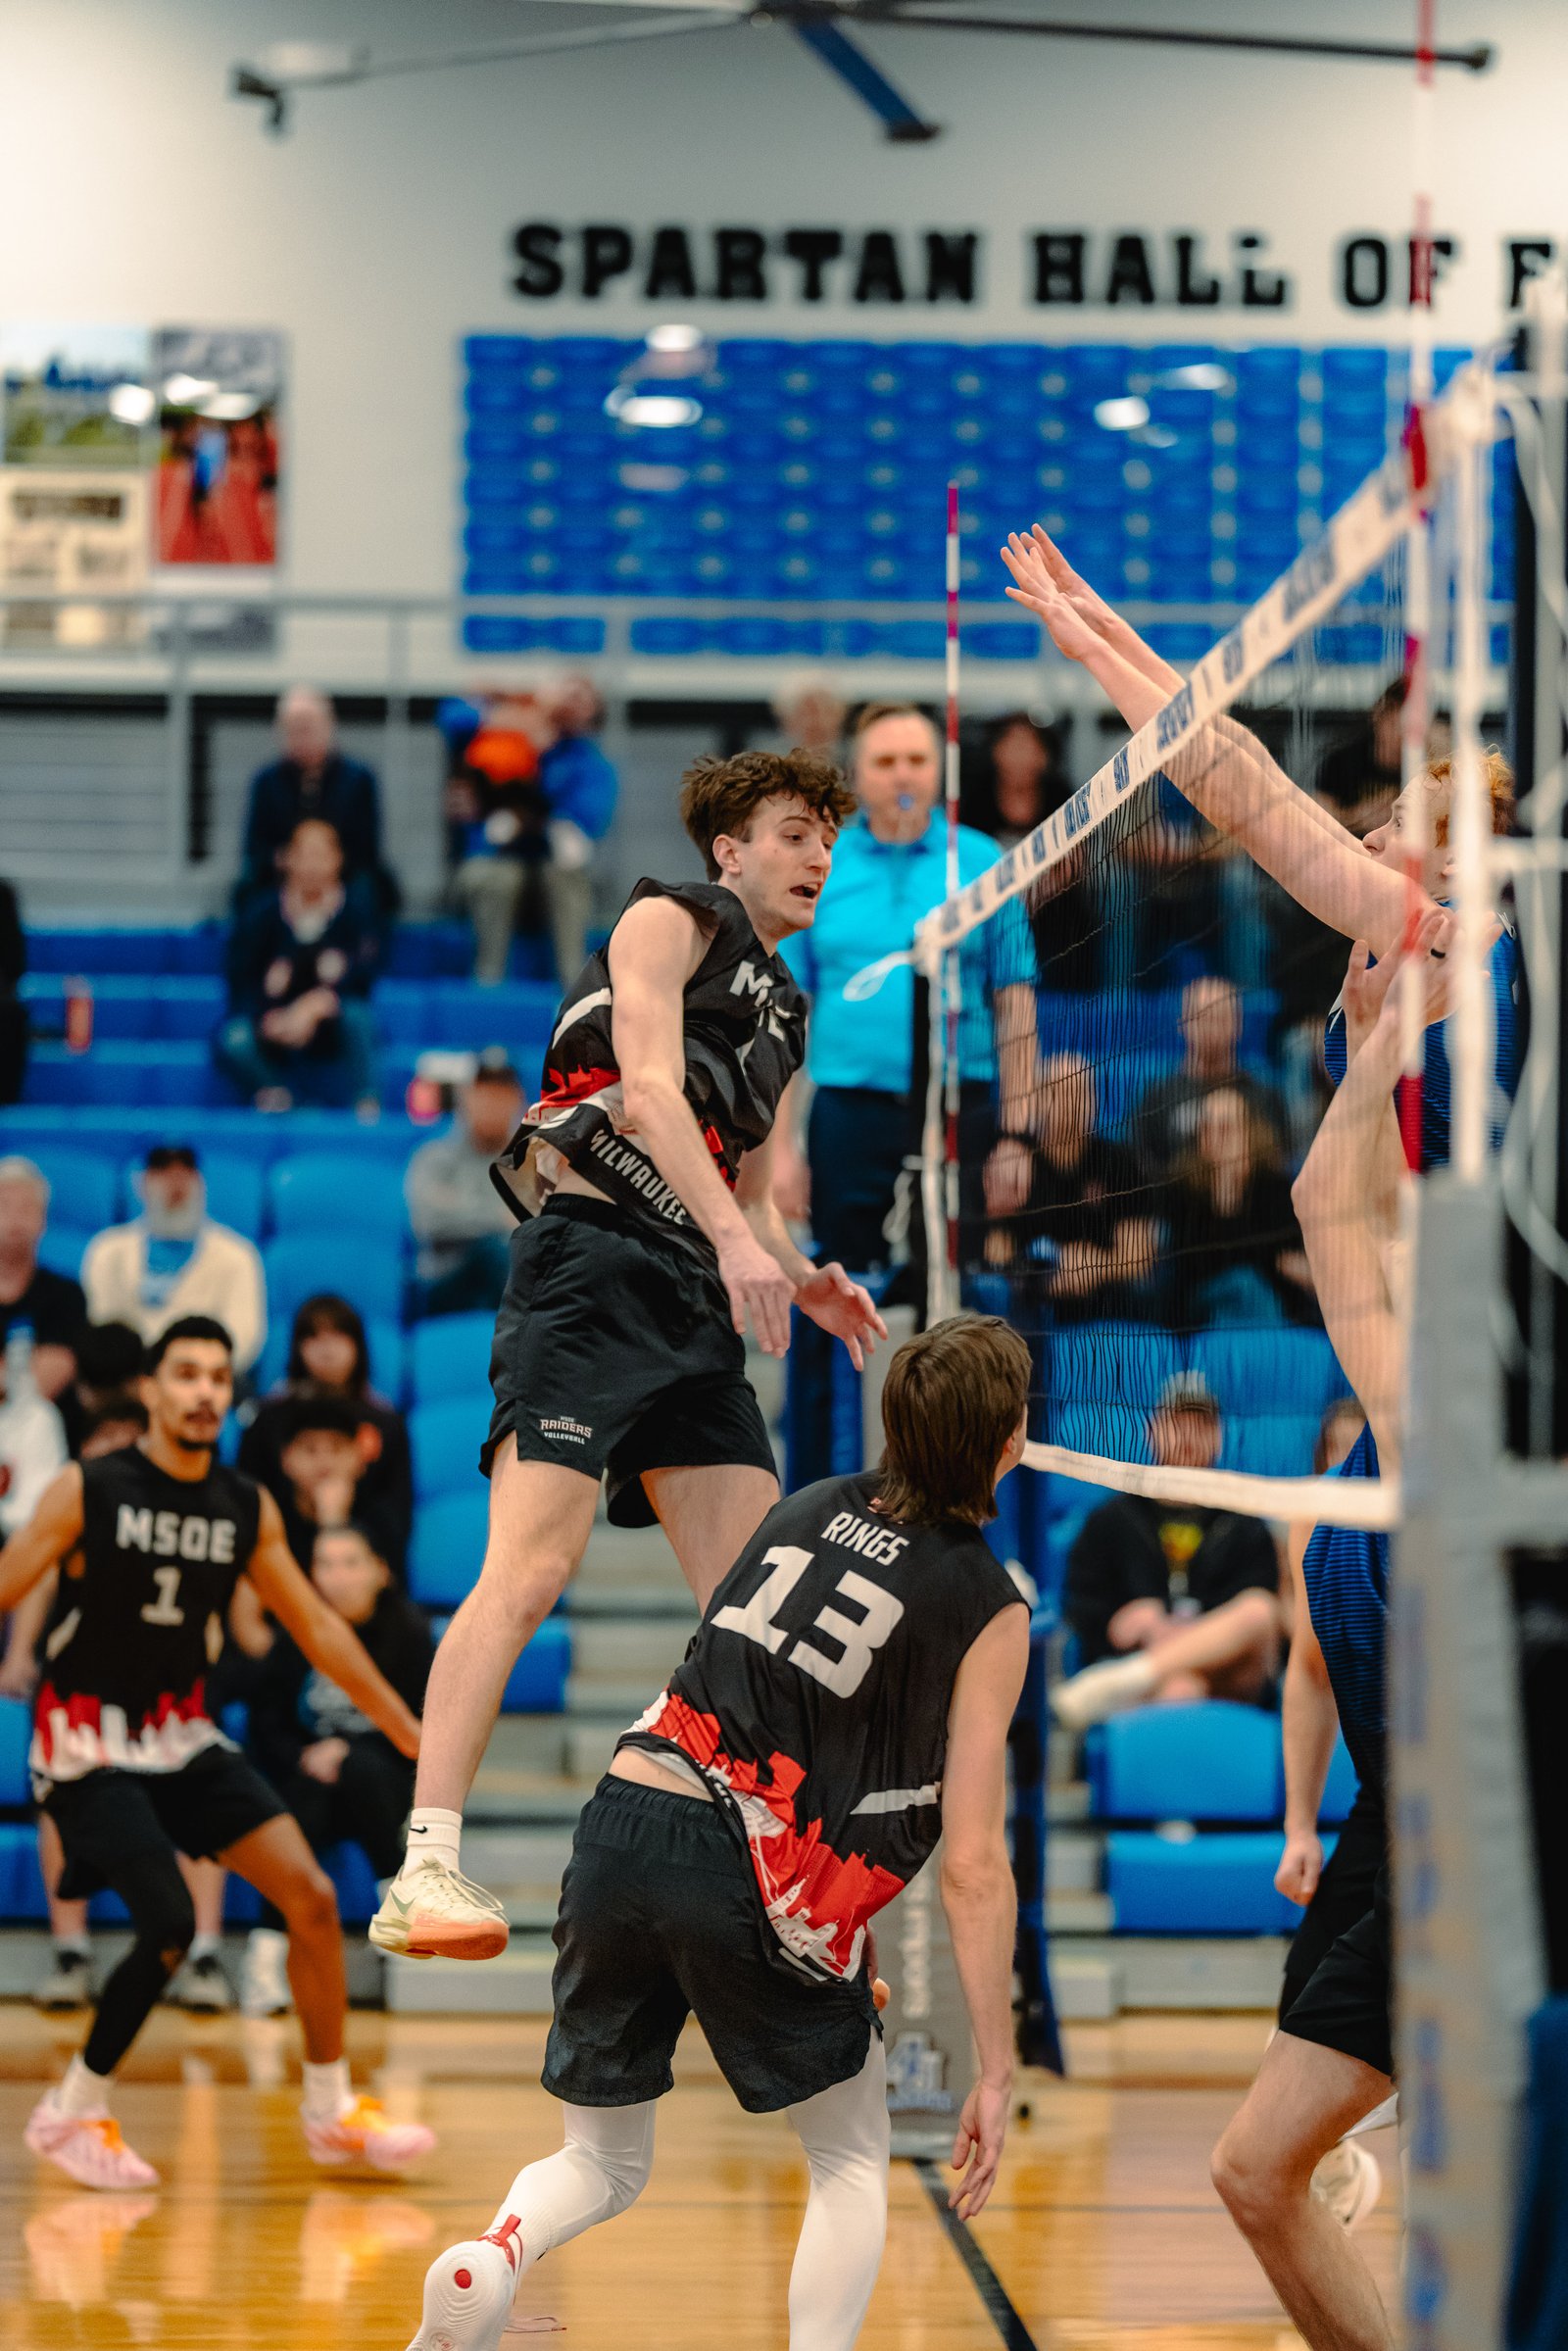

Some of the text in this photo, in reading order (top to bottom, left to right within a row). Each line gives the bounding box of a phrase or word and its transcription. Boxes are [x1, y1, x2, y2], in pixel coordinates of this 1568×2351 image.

[513, 223, 978, 303] SPARTAN
[1033, 232, 1287, 308] HALL
[1344, 238, 1453, 308] OF
[589, 1128, 688, 1226] MILWAUKEE
[539, 1418, 593, 1440] RAIDERS
[543, 1431, 586, 1445] VOLLEYBALL
[116, 1503, 237, 1565] MSOE
[820, 1511, 910, 1566] RINGS
[140, 1565, 186, 1628] 1
[710, 1545, 905, 1699] 13
